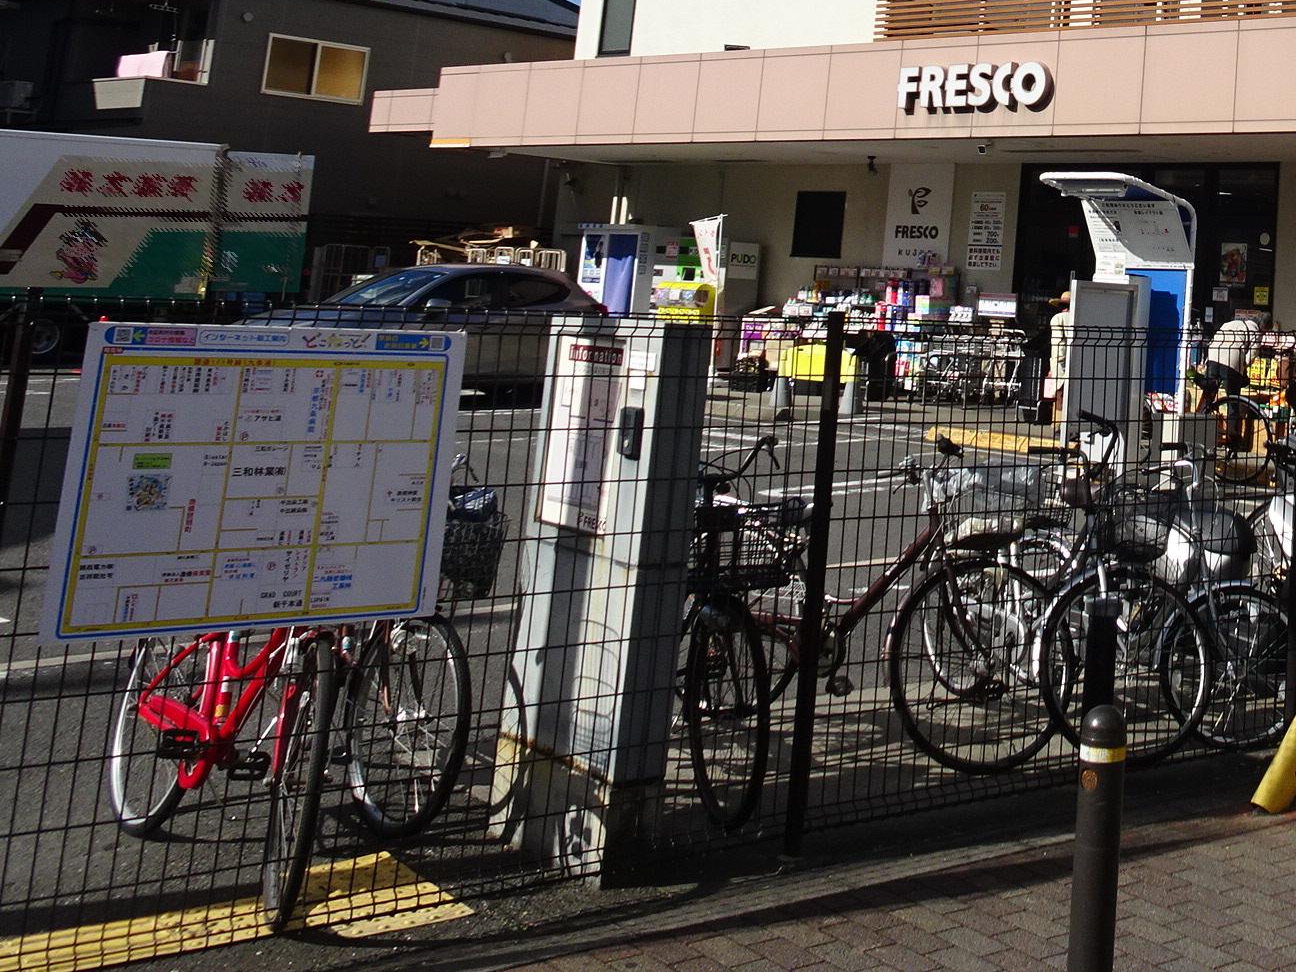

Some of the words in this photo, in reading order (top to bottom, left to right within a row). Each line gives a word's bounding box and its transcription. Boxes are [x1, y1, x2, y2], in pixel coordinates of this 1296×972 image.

[897, 61, 1052, 112] FRESCO
[894, 225, 939, 240] FRESCO
[731, 253, 756, 265] PUDO
